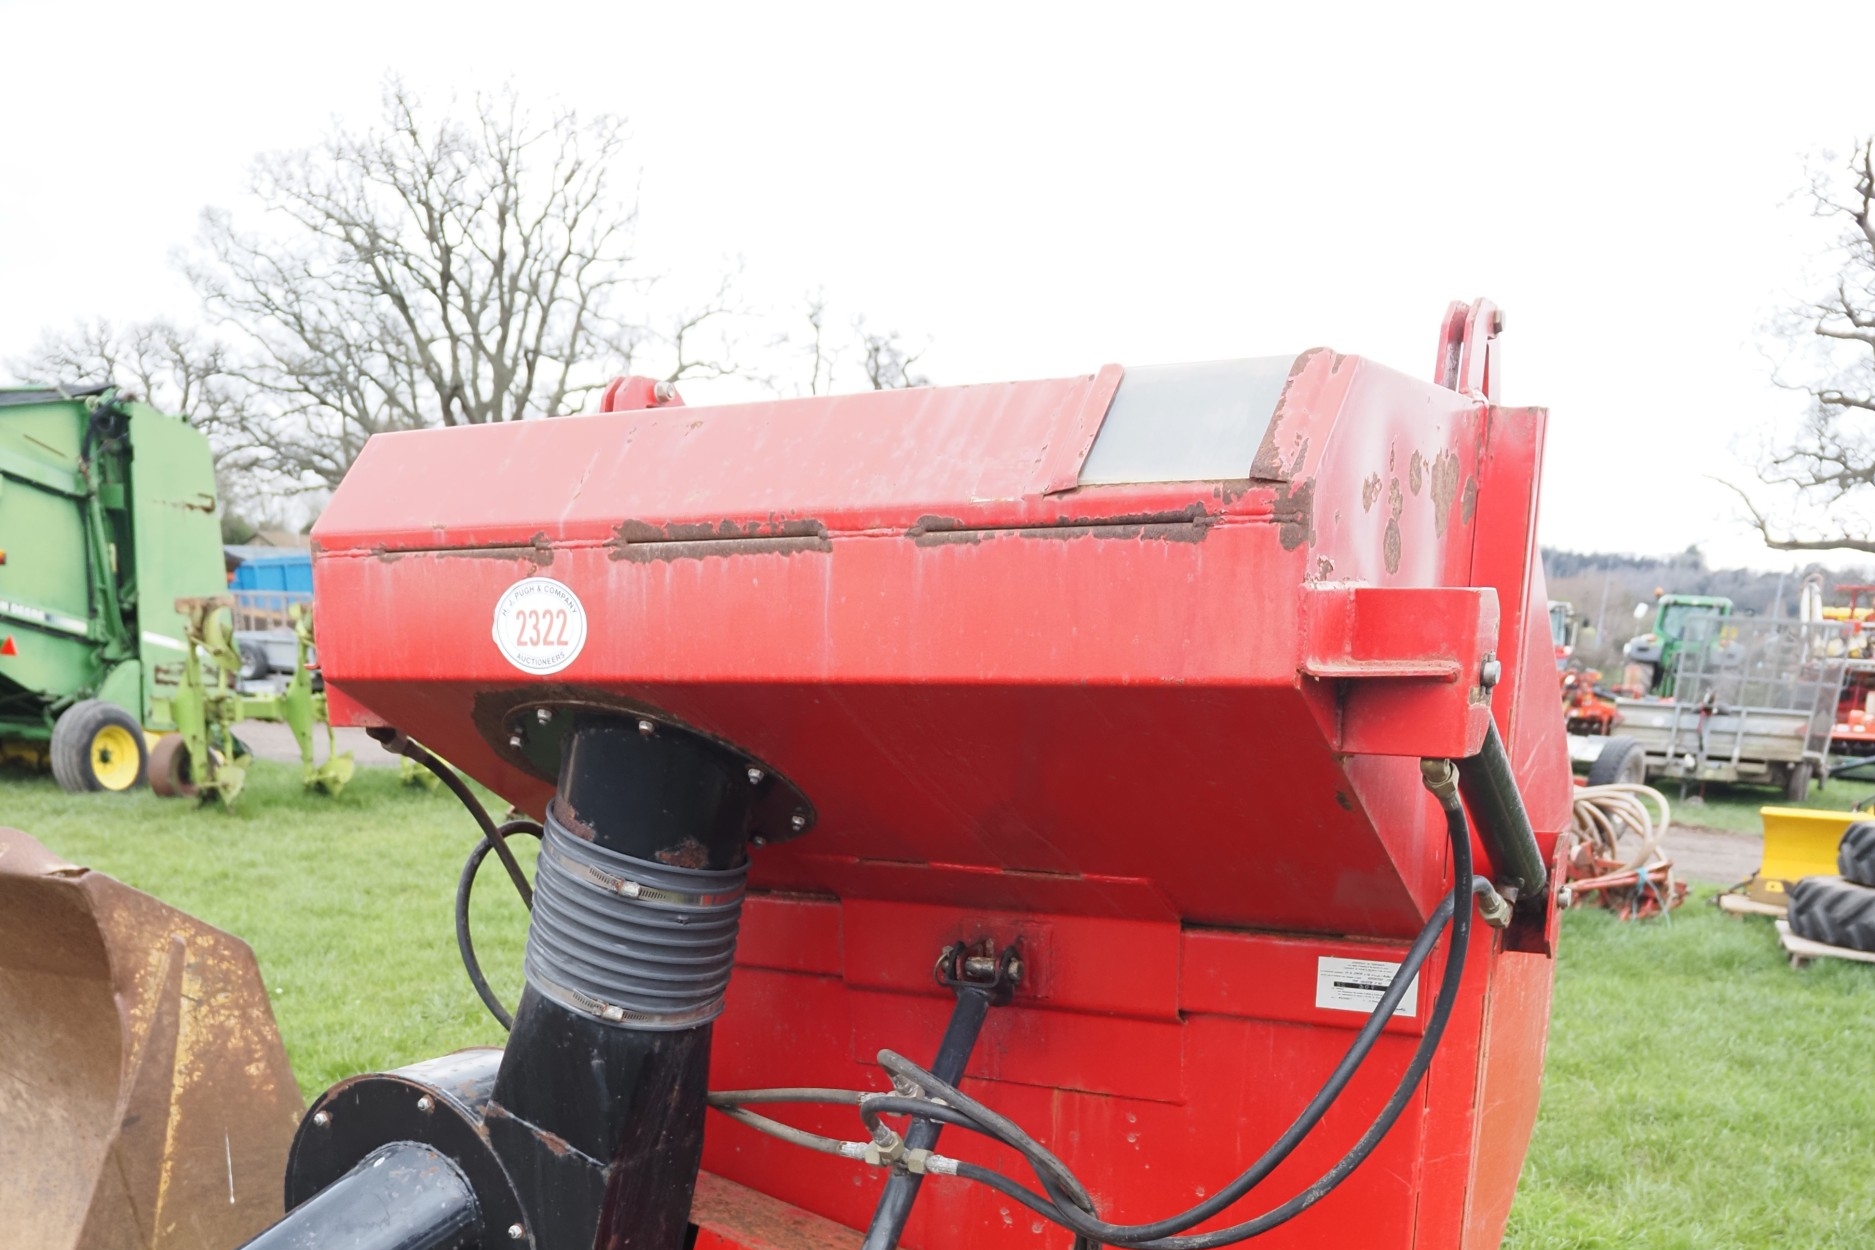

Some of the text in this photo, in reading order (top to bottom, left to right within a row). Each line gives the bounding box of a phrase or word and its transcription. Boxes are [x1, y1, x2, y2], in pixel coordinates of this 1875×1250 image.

[514, 586, 534, 600] PUGH
[544, 585, 577, 614] COMPANY
[516, 609, 569, 647] 2322
[516, 651, 565, 666] AUCTIONEERS
